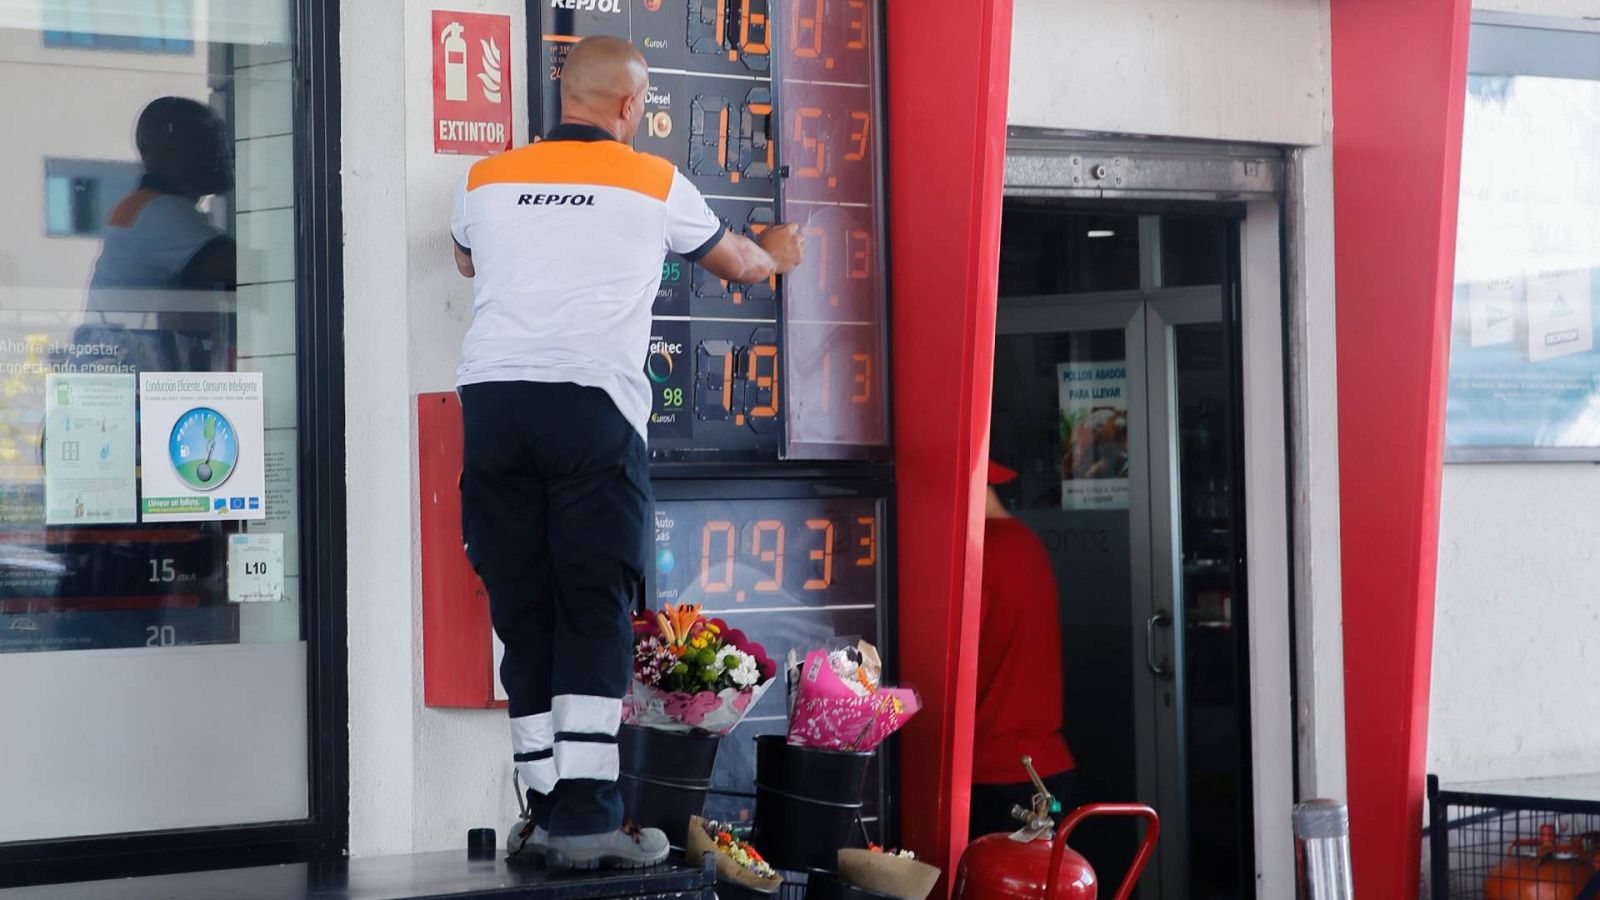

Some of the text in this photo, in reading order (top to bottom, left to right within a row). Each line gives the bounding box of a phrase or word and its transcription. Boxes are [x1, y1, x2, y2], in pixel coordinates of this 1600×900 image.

[551, 0, 621, 13] REPSOL
[645, 92, 671, 105] Diesel
[439, 119, 505, 144] EXTINTOR
[517, 194, 595, 206] REPSOL
[0, 340, 119, 358] Ahorra al repostar
[650, 342, 683, 354] efitec
[663, 388, 683, 407] 98
[1069, 387, 1121, 400] PARA LLEVAR
[655, 516, 674, 528] Auto
[656, 529, 670, 541] Gas
[149, 559, 176, 582] 15
[245, 561, 267, 575] L10
[146, 625, 176, 648] 20
